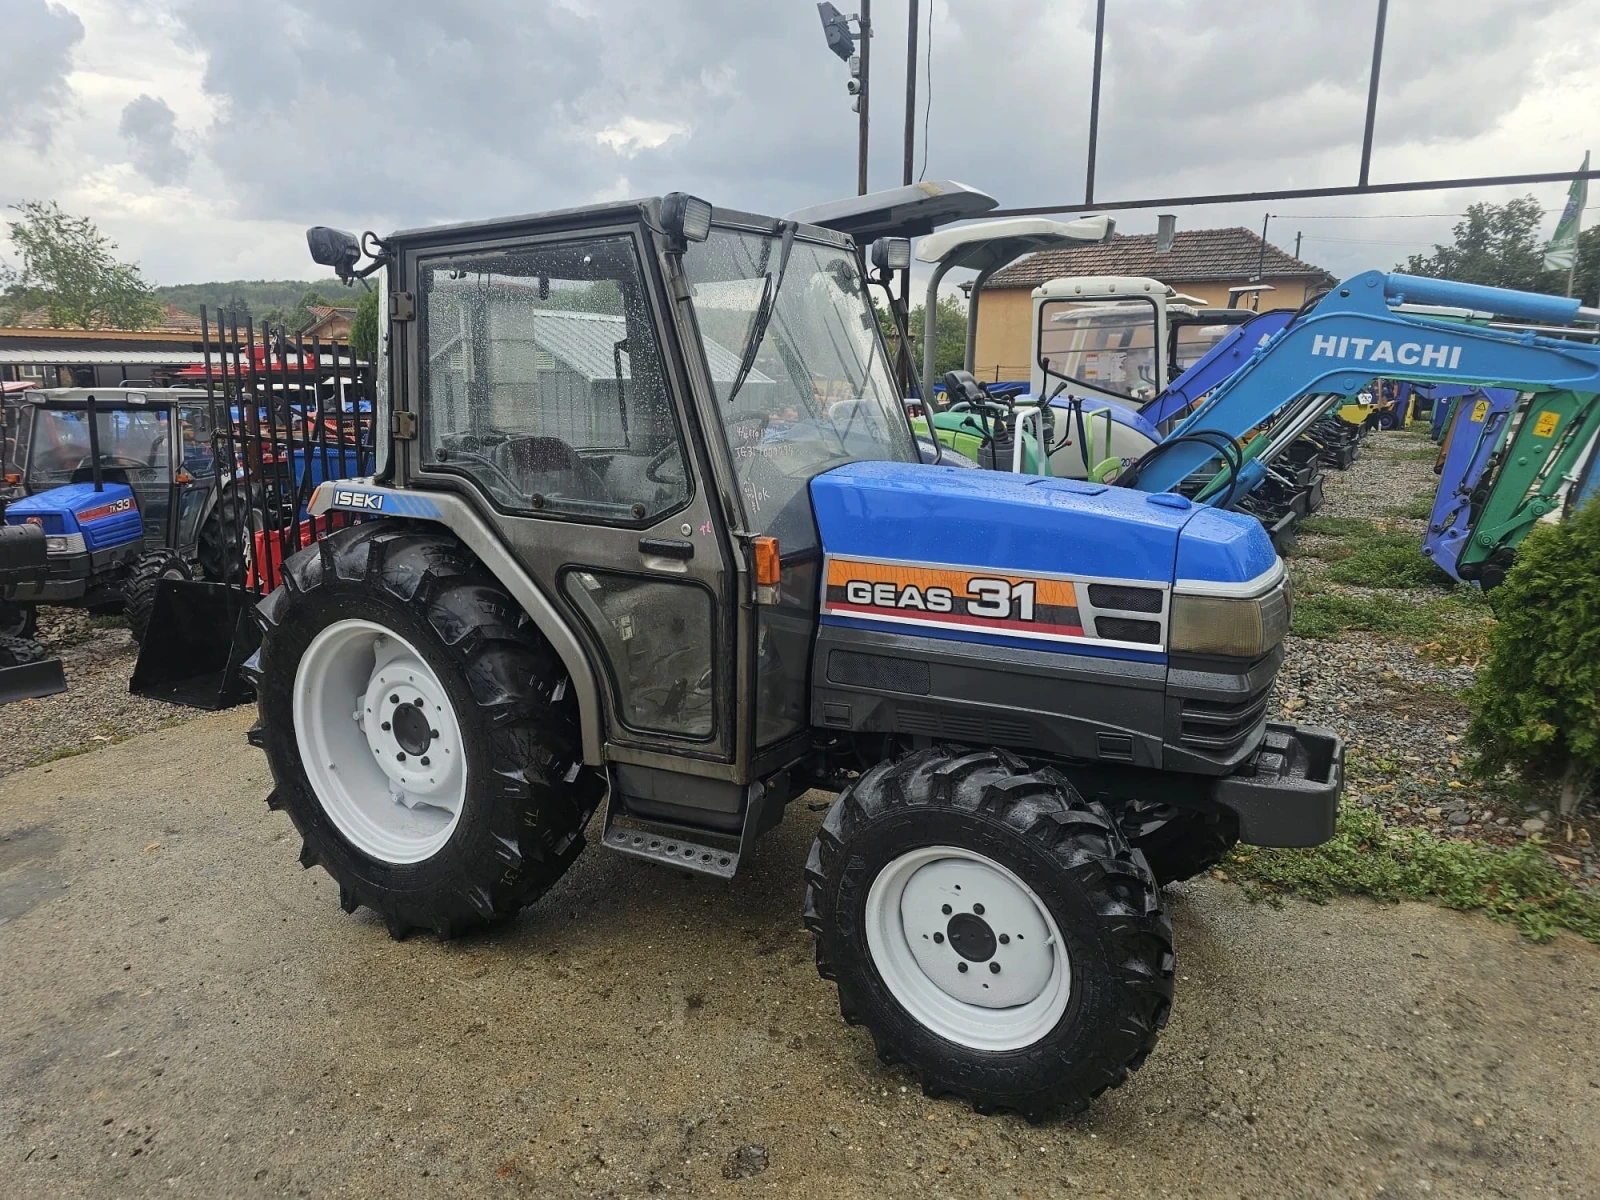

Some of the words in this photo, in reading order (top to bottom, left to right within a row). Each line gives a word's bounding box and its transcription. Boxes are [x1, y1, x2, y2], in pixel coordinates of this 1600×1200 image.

[1311, 334, 1463, 369] HITACHI
[334, 490, 384, 510] ISEKI
[847, 580, 952, 613] GEAS
[967, 577, 1037, 622] 31
